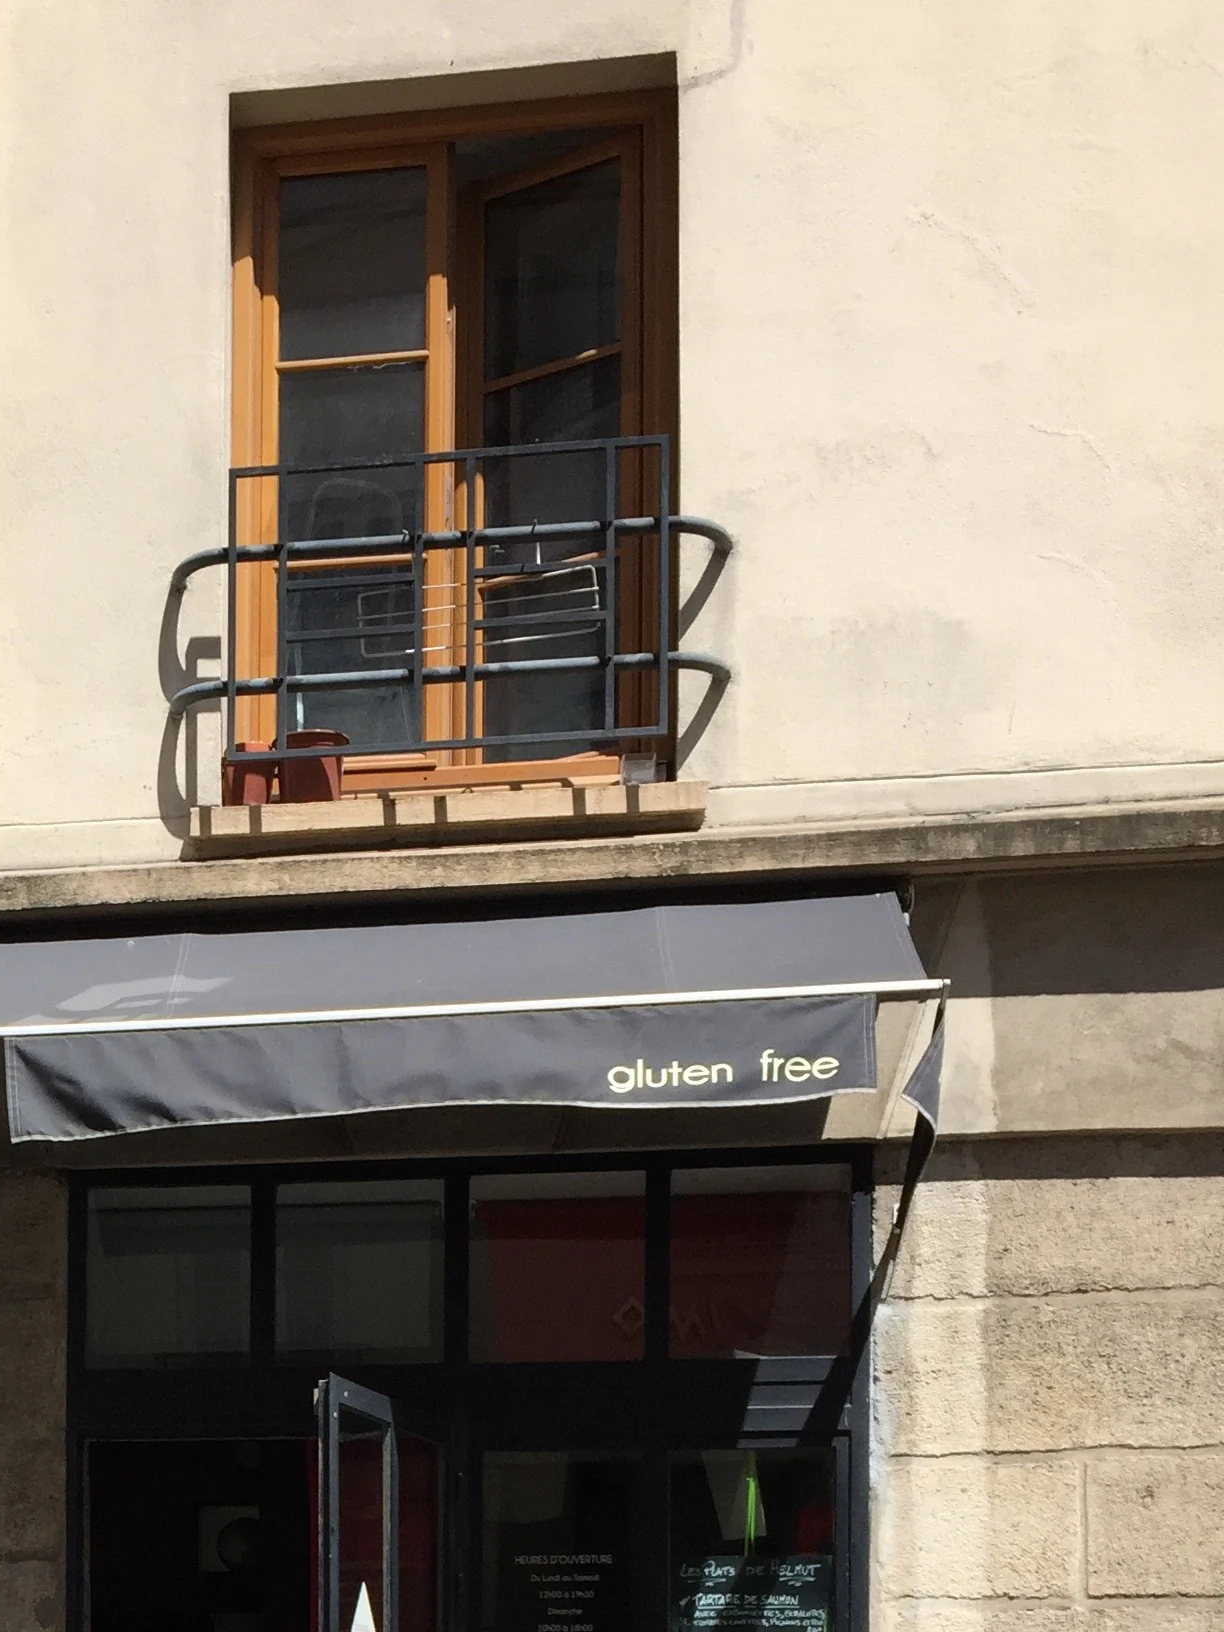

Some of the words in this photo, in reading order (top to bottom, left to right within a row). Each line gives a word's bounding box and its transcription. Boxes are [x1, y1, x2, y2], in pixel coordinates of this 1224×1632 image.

[607, 1058, 733, 1093] gluten
[760, 1048, 840, 1082] free
[514, 1555, 548, 1565] HEURES
[702, 1560, 736, 1577] PLATS
[692, 1593, 740, 1606] TARTARE
